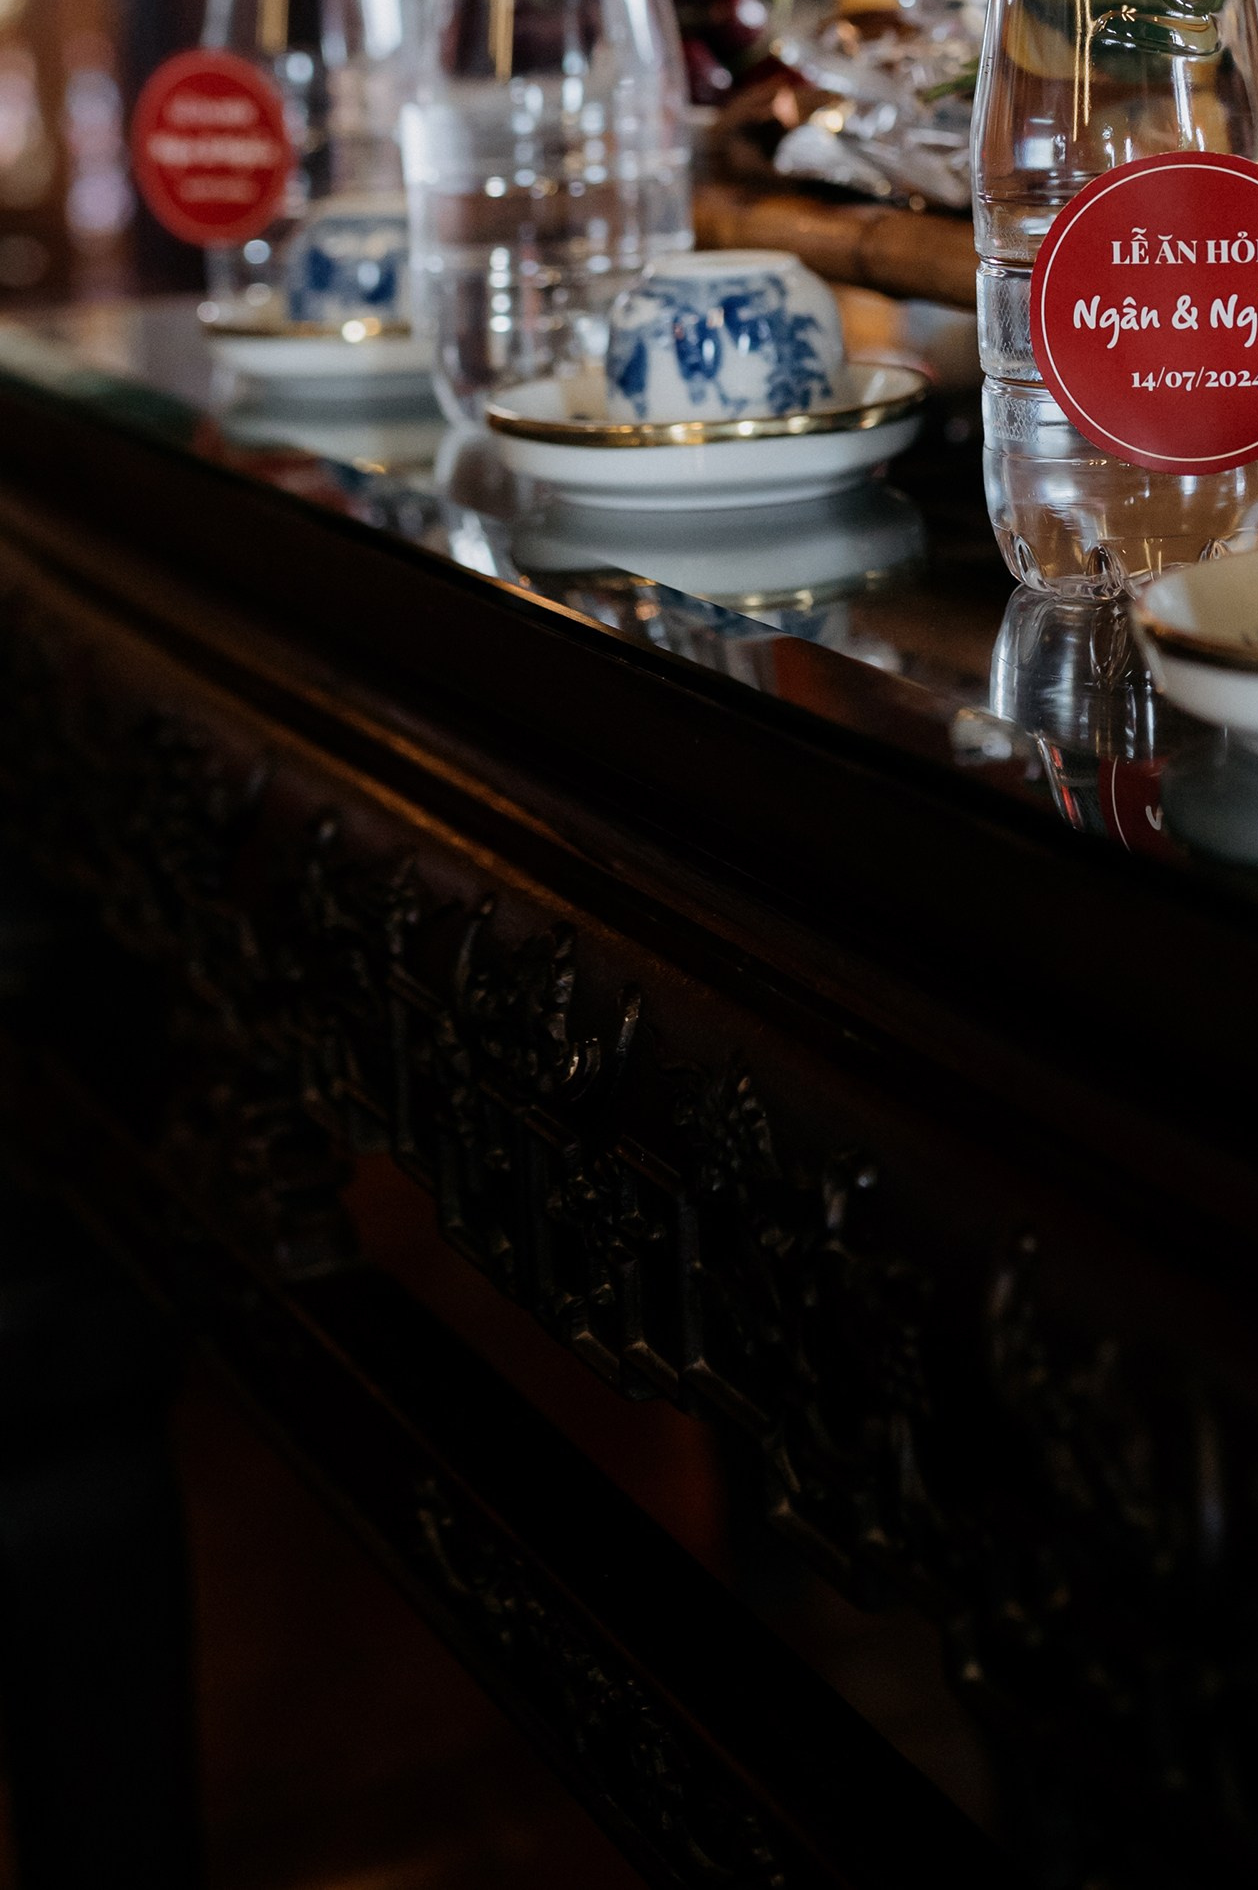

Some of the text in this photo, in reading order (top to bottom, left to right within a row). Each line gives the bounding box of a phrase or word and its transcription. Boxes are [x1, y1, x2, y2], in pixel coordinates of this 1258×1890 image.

[1111, 227, 1149, 265] LỄ
[1154, 234, 1197, 264] ĂN
[1073, 295, 1160, 349] Ngân
[1171, 294, 1198, 330] &
